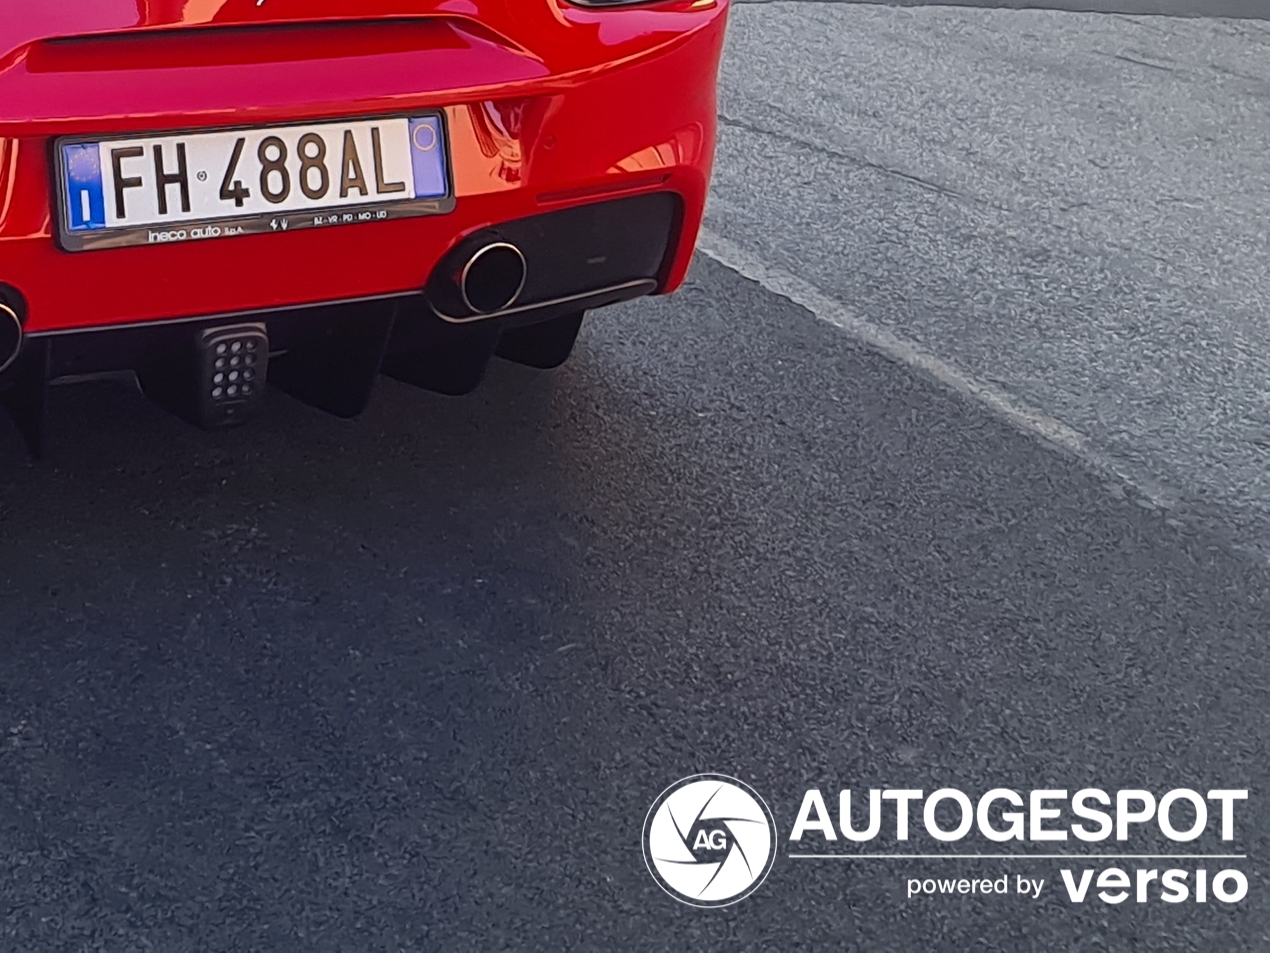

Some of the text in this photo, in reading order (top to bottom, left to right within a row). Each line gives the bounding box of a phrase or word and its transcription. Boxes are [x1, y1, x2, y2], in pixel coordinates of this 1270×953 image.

[111, 142, 191, 219] FH
[219, 127, 406, 207] 488AL
[190, 226, 221, 239] auto
